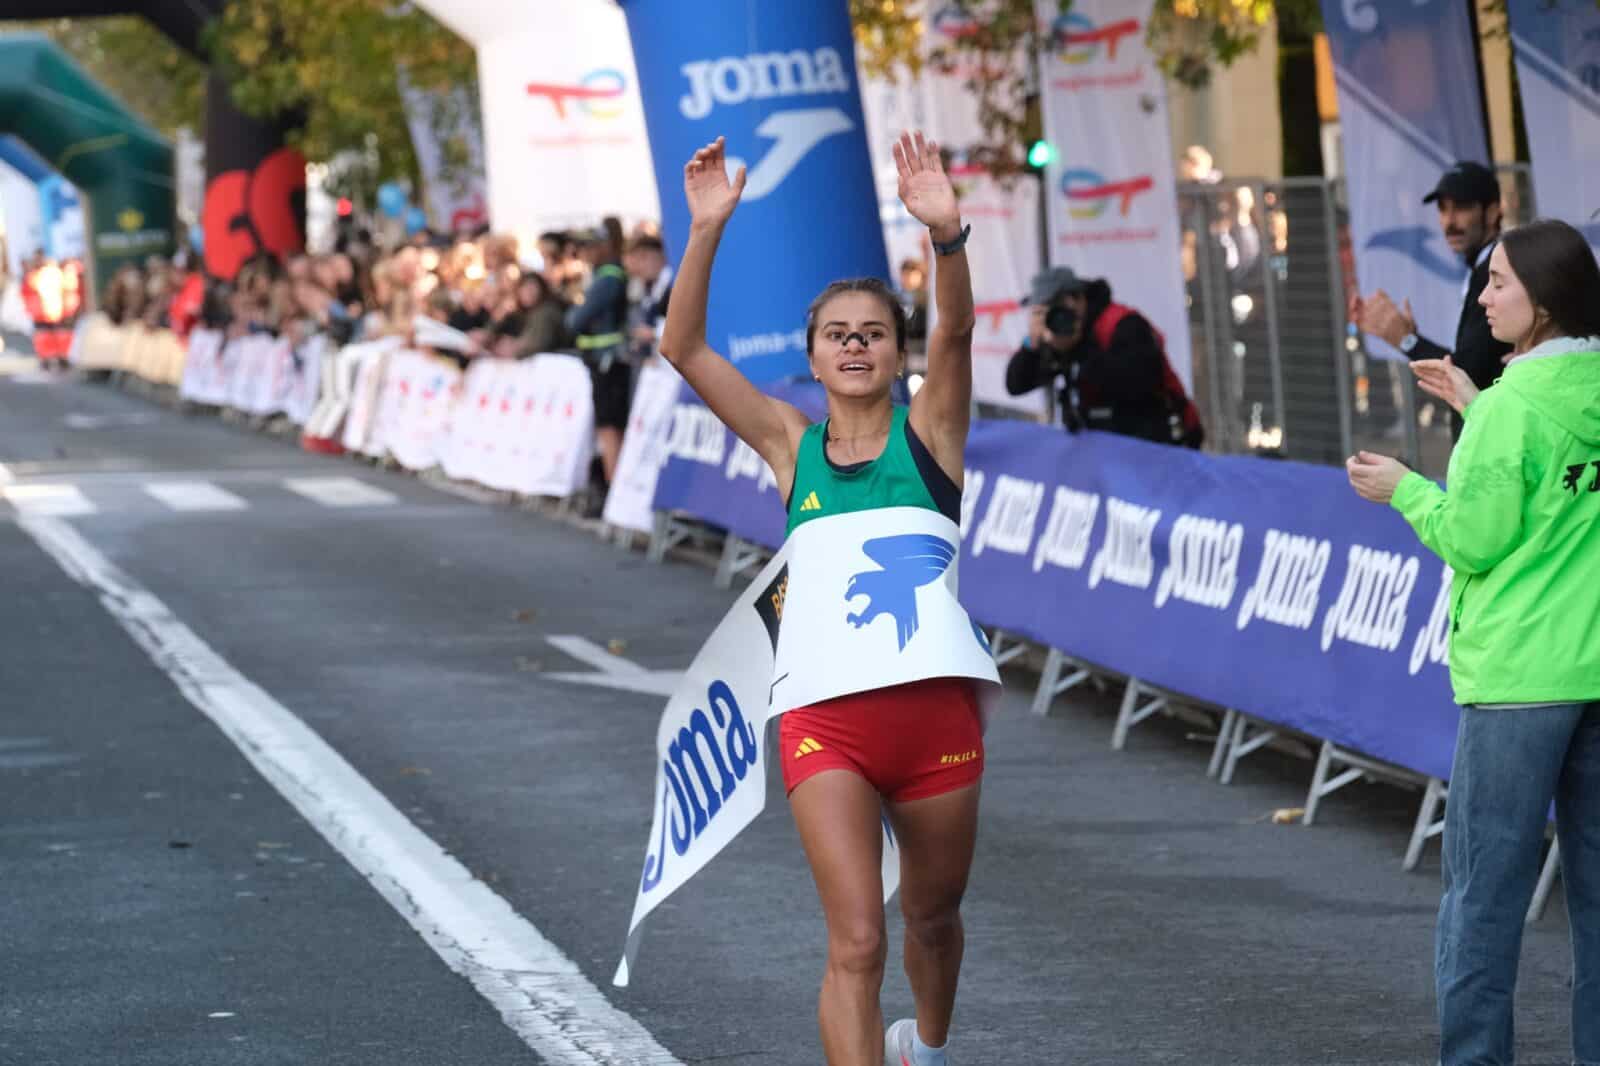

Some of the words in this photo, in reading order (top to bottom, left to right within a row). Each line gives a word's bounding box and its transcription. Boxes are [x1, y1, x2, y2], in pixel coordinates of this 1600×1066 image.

[1154, 513, 1244, 608] Joma
[1236, 528, 1332, 631] Joma
[1320, 544, 1420, 653] Joma
